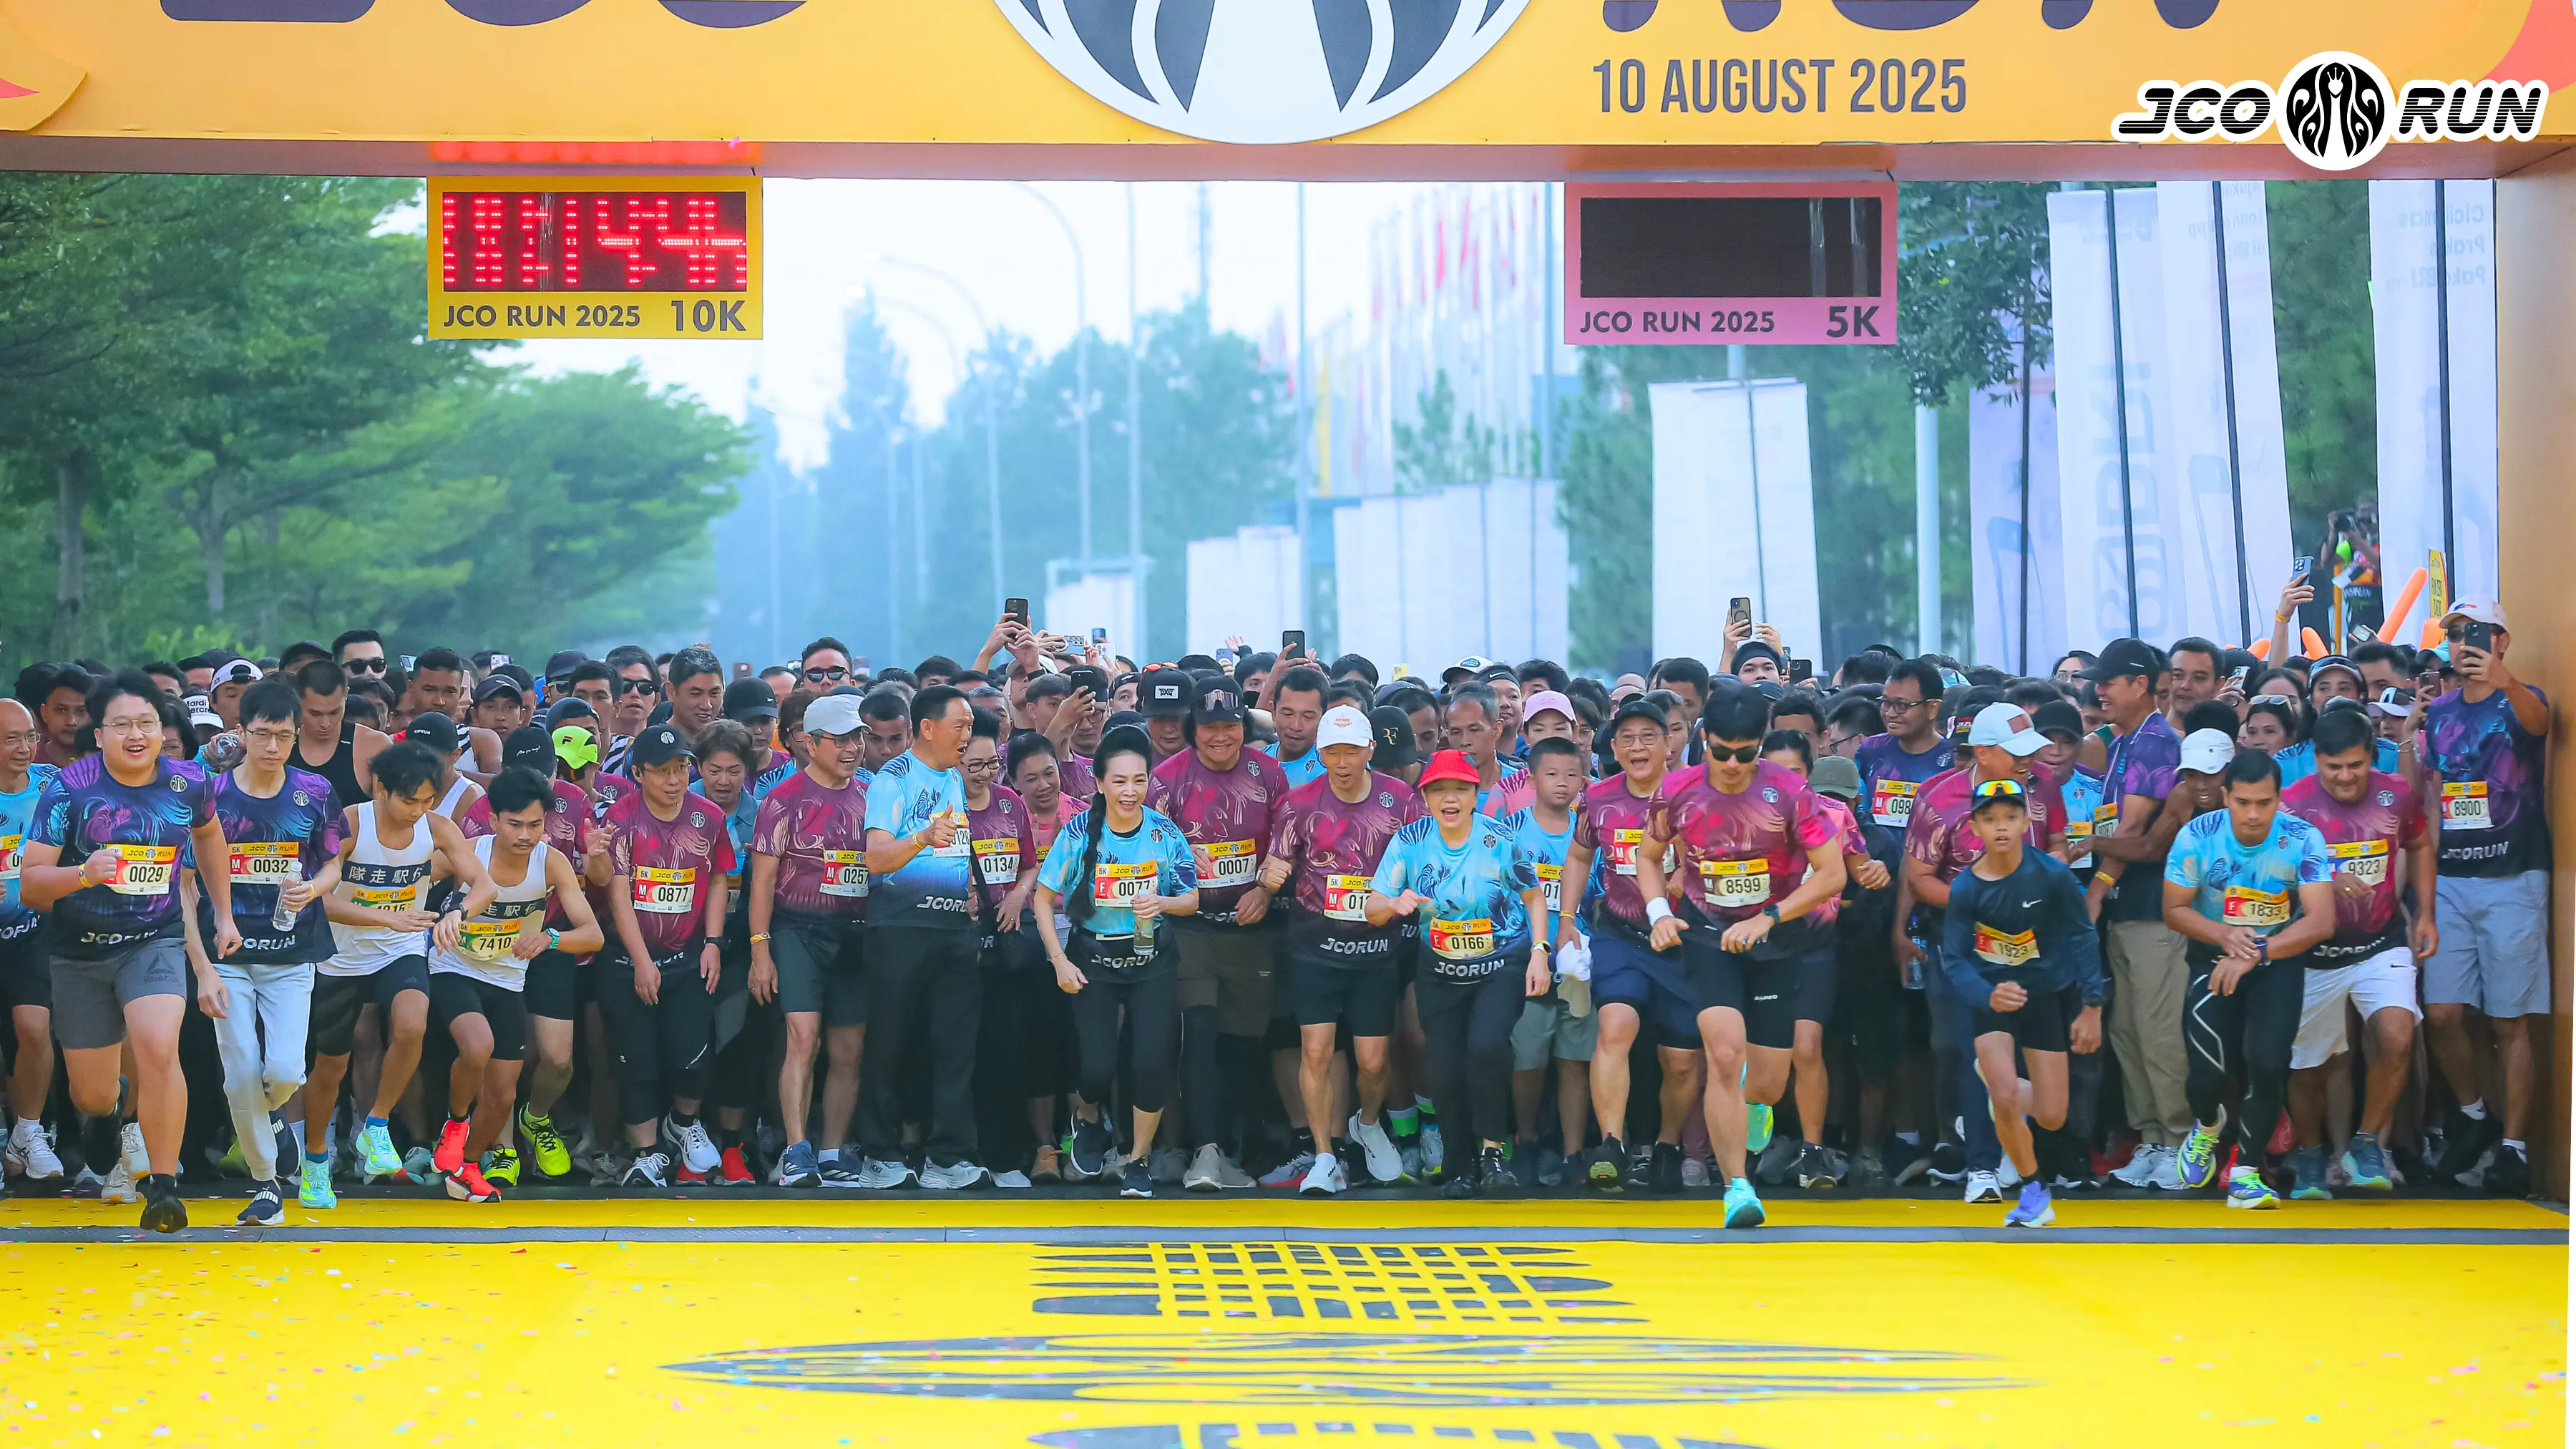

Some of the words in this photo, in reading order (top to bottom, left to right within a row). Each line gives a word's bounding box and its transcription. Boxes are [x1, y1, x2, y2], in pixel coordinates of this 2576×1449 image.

[1593, 59, 1646, 113] 10
[1661, 59, 1835, 113] AUGUST
[1850, 59, 1966, 113] 2025
[444, 305, 497, 327] JCO
[507, 305, 566, 326] RUN
[575, 305, 640, 327] 2025
[670, 299, 747, 332] 10K
[1580, 311, 1633, 333] JCO
[1642, 311, 1700, 333] RUN
[1711, 311, 1775, 333] 2025
[1826, 306, 1881, 338] 5K
[1892, 799, 1911, 814] 098
[2454, 800, 2481, 816] 8900
[1616, 847, 1624, 859] M
[232, 859, 240, 869] M
[254, 859, 289, 873] 0032
[984, 857, 1014, 873] 0134
[1219, 858, 1249, 875] 0007
[2348, 859, 2380, 876] 9323
[130, 866, 163, 882] 0029
[826, 867, 835, 878] M
[844, 868, 868, 884] 0257
[639, 884, 647, 895] M
[1099, 882, 1106, 893] F
[1119, 880, 1150, 896] 0077
[1544, 883, 1558, 899] 01
[1726, 878, 1760, 894] 8599
[658, 887, 689, 902] 0877
[1329, 893, 1337, 904] M
[1349, 894, 1370, 909] 01
[917, 896, 966, 912] JCORU
[2251, 904, 2282, 917] 1833
[241, 935, 296, 950] ORUN
[479, 937, 512, 950] 7410
[1320, 937, 1388, 955] JCORUN
[1452, 937, 1485, 950] 0166
[1434, 959, 1505, 977] JCORUN
